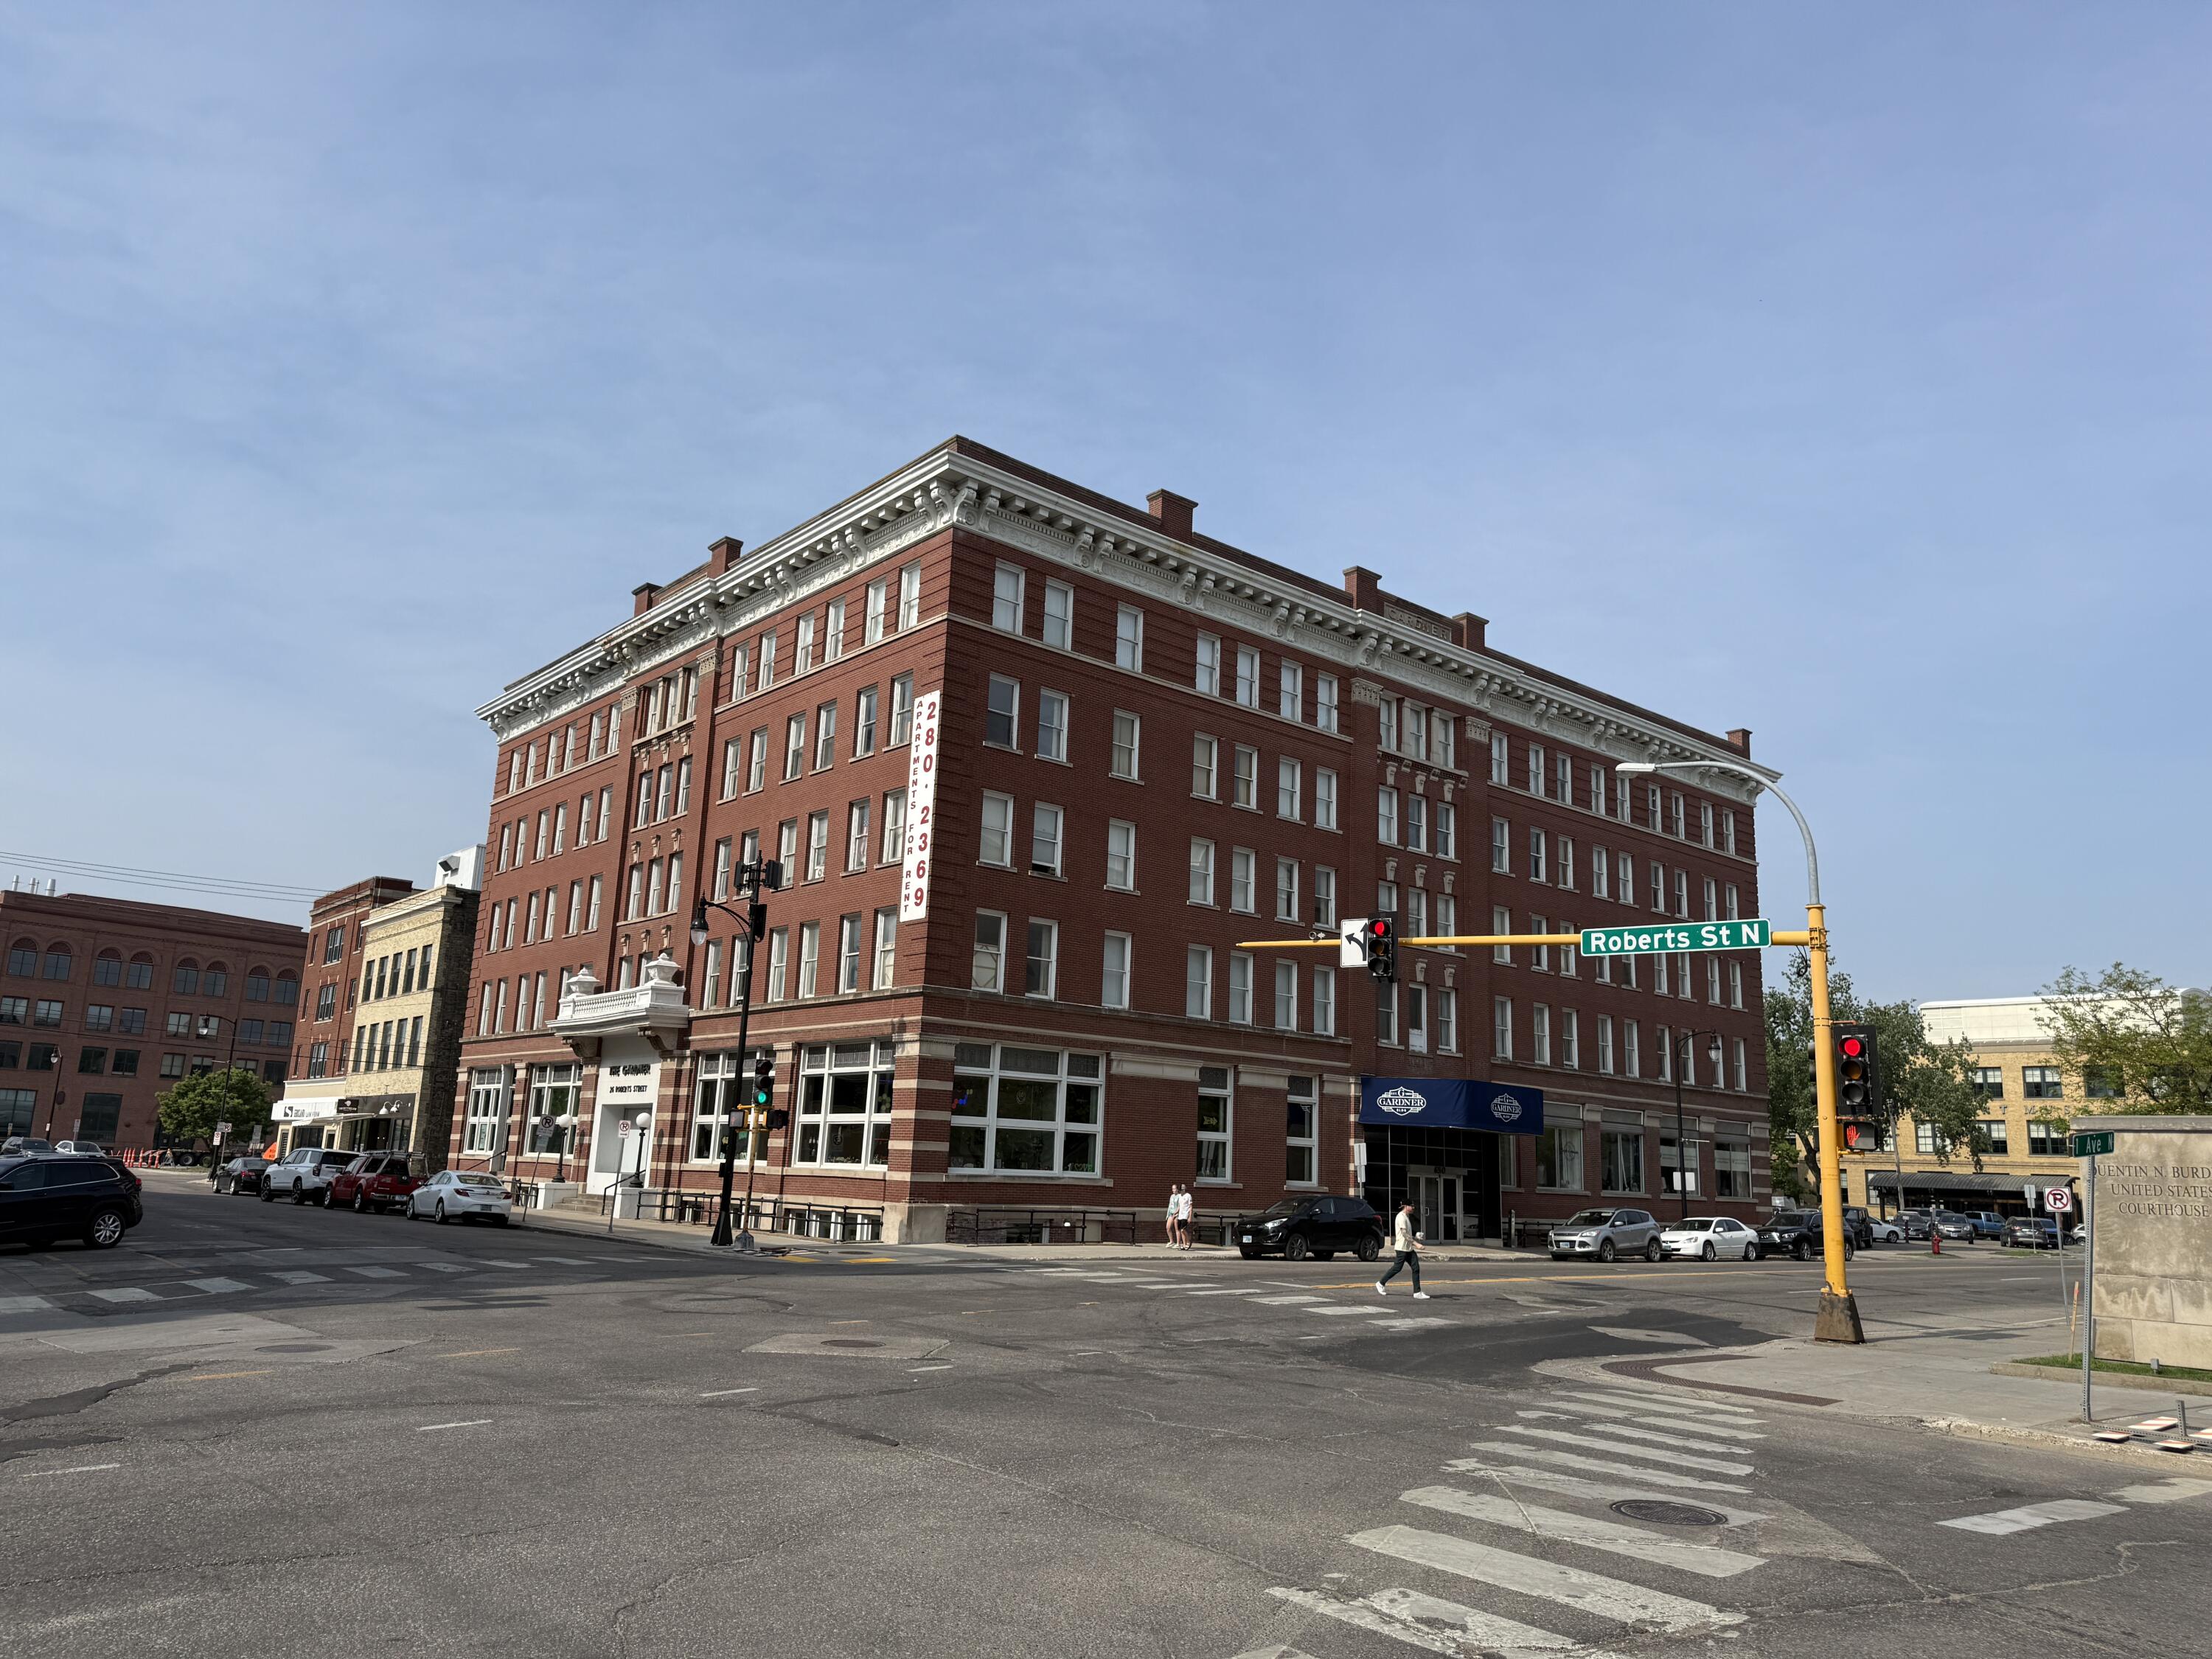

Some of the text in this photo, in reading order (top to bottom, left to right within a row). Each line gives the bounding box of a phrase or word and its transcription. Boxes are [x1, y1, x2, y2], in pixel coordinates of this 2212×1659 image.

[911, 700, 923, 810] APARTMENTS
[1590, 923, 1759, 952] Roberts St N
[1379, 1098, 1424, 1107] GARDNER
[1492, 1104, 1520, 1113] GARDNER
[2076, 1133, 2112, 1155] 1 Ave N
[2153, 1166, 2166, 1178] N.
[2172, 1166, 2212, 1179] BURD
[2111, 1183, 2163, 1196] UNITED
[2118, 1202, 2211, 1217] COURTHOUSE
